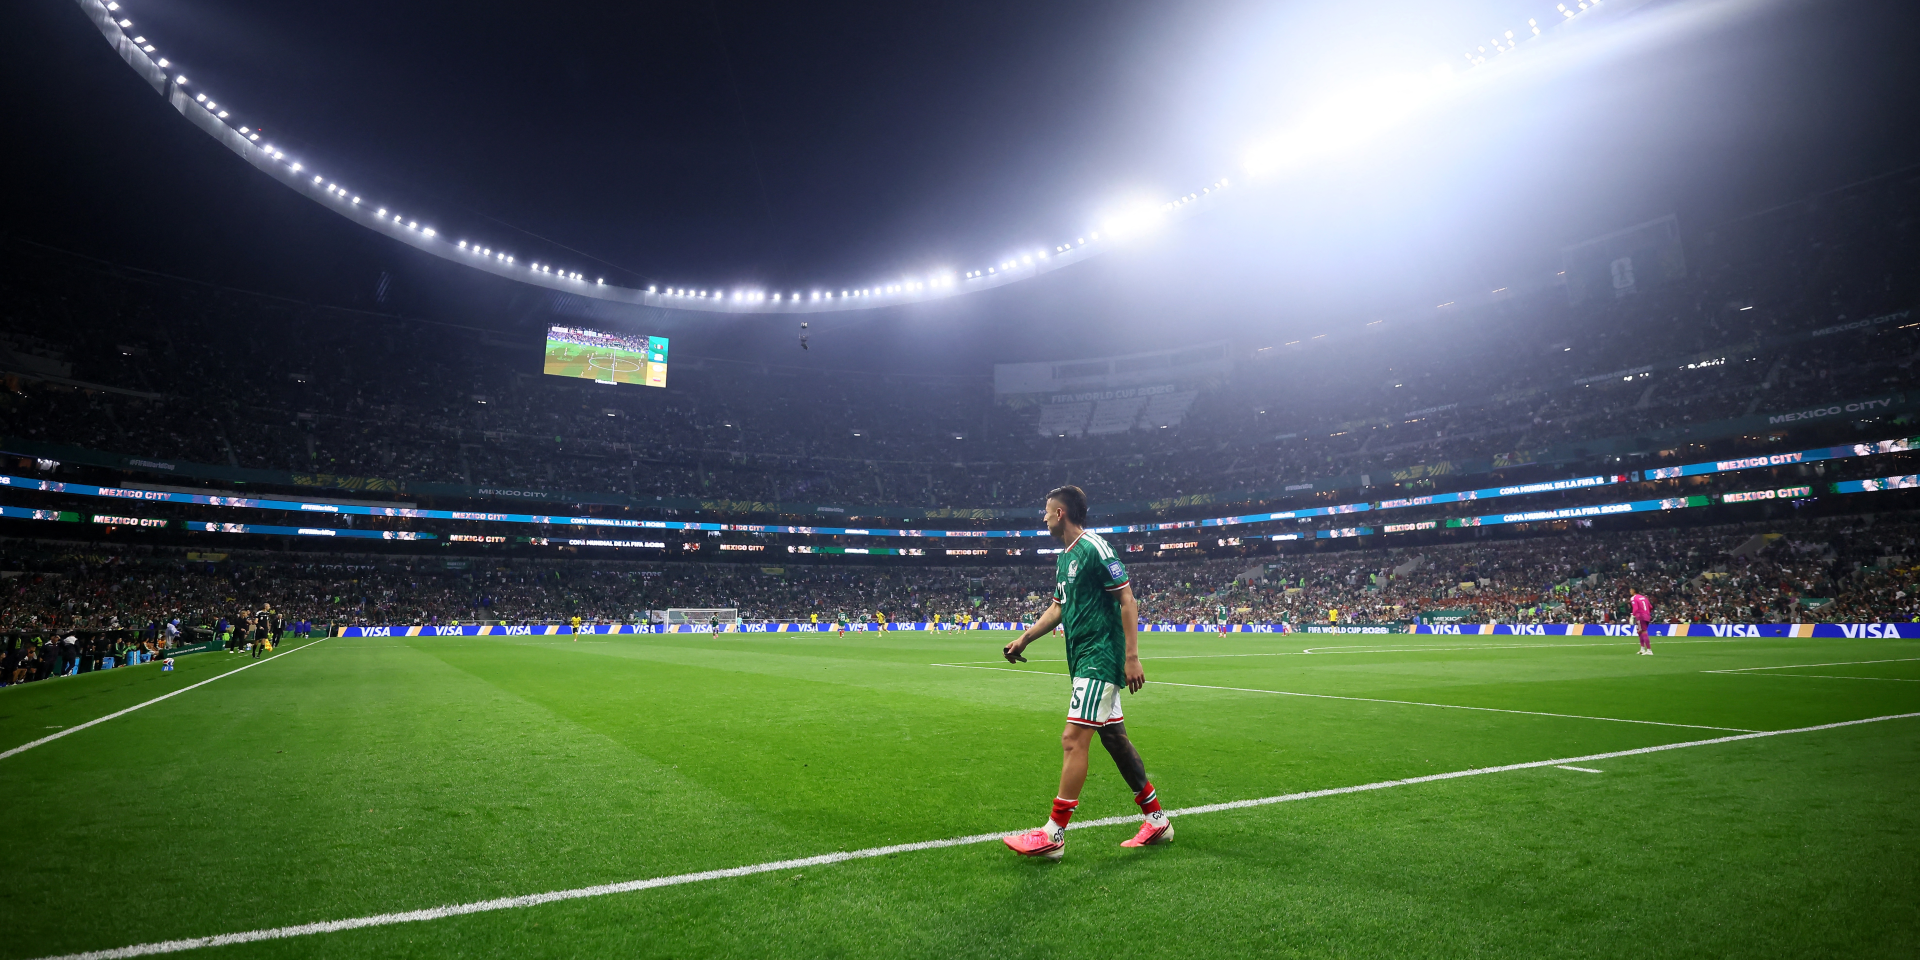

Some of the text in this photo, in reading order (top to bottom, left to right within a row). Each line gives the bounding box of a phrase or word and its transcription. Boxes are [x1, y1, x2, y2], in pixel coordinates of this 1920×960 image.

[1051, 384, 1175, 404] FIFA WORLD CUP 2026
[1769, 398, 1892, 425] MEXICO CITY
[1717, 453, 1803, 471] MEXICO CITY
[1499, 487, 1520, 495] COPA
[1520, 483, 1554, 493] MUNDIAL
[1555, 481, 1566, 489] DE
[1566, 480, 1577, 488] LA
[1578, 478, 1596, 487] FIFA
[98, 487, 172, 501] MEXICO CITY
[1723, 487, 1810, 503] MEXICO CITY
[1413, 496, 1433, 505] CITY
[452, 512, 486, 520] MEXICO
[1524, 511, 1559, 520] MUNDIAL
[1559, 509, 1570, 517] DE
[1570, 508, 1581, 516] LA
[1582, 506, 1600, 515] FIFA
[1601, 504, 1632, 514] 2026
[93, 514, 168, 527] MEXICO CITY
[1384, 521, 1437, 533] MEXICO CITY
[450, 534, 485, 543] MEXICO
[358, 627, 391, 637] VISA
[433, 626, 463, 636] VISA
[501, 625, 532, 635] VISA
[631, 625, 656, 634] VISA
[742, 624, 767, 632] VISA
[893, 622, 916, 631] VISA
[988, 622, 1006, 631] VISA
[1158, 624, 1177, 632] VISA
[1249, 624, 1273, 632] VISA
[1308, 626, 1321, 634] FIFA
[1349, 626, 1361, 634] CUP
[1427, 624, 1462, 635] VISA
[1507, 624, 1546, 636] VISA
[1600, 624, 1639, 637] VISA
[1706, 624, 1761, 638] VISA
[1834, 624, 1901, 639] VISA
[1071, 686, 1084, 710] 5
